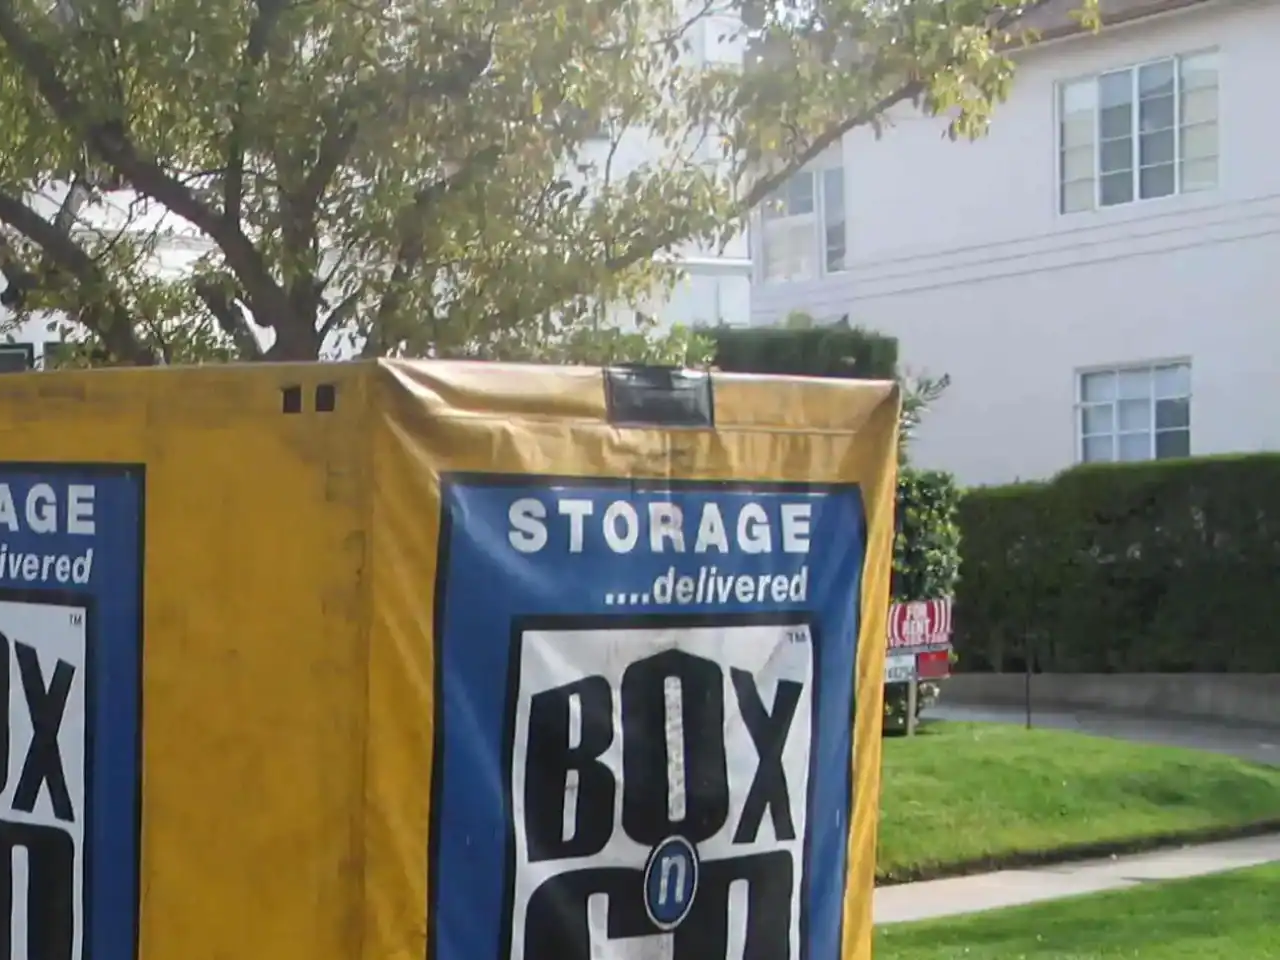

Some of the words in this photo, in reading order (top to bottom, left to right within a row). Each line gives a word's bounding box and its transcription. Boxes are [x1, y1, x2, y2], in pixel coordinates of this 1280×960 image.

[508, 498, 812, 554] STORAGE
[523, 648, 803, 863] BOX
[657, 852, 687, 905] n
